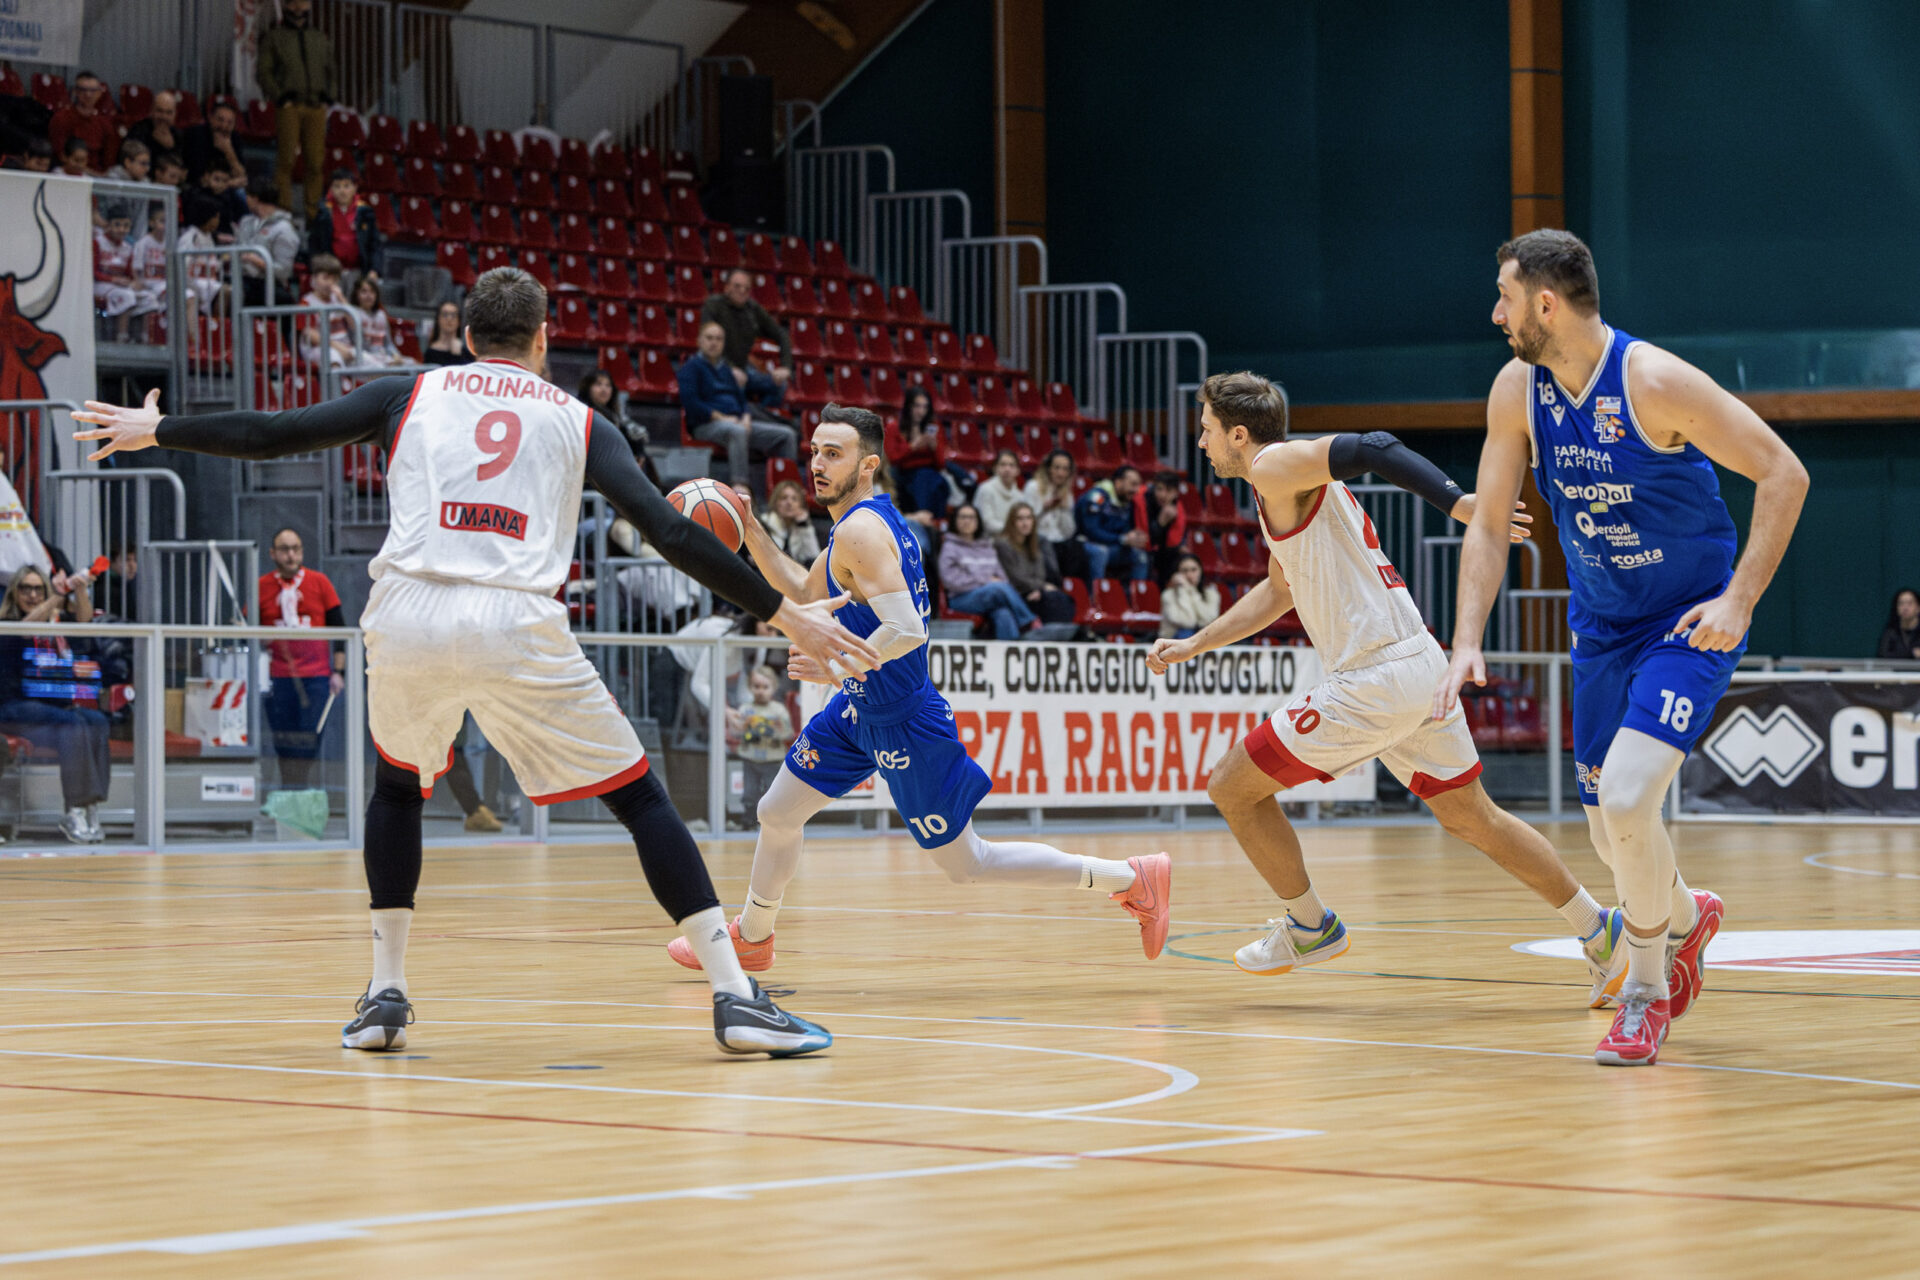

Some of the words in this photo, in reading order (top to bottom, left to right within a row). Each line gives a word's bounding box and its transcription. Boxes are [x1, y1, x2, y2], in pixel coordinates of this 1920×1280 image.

[443, 370, 570, 406] MOLINARO
[1537, 382, 1557, 405] 18
[474, 410, 522, 482] 9
[445, 505, 521, 535] UMANA
[1005, 646, 1156, 700] CORAGGIO,
[1165, 650, 1296, 694] ORGOGLIO
[1286, 695, 1321, 735] 20
[1659, 688, 1694, 733] 18
[909, 814, 948, 839] 10
